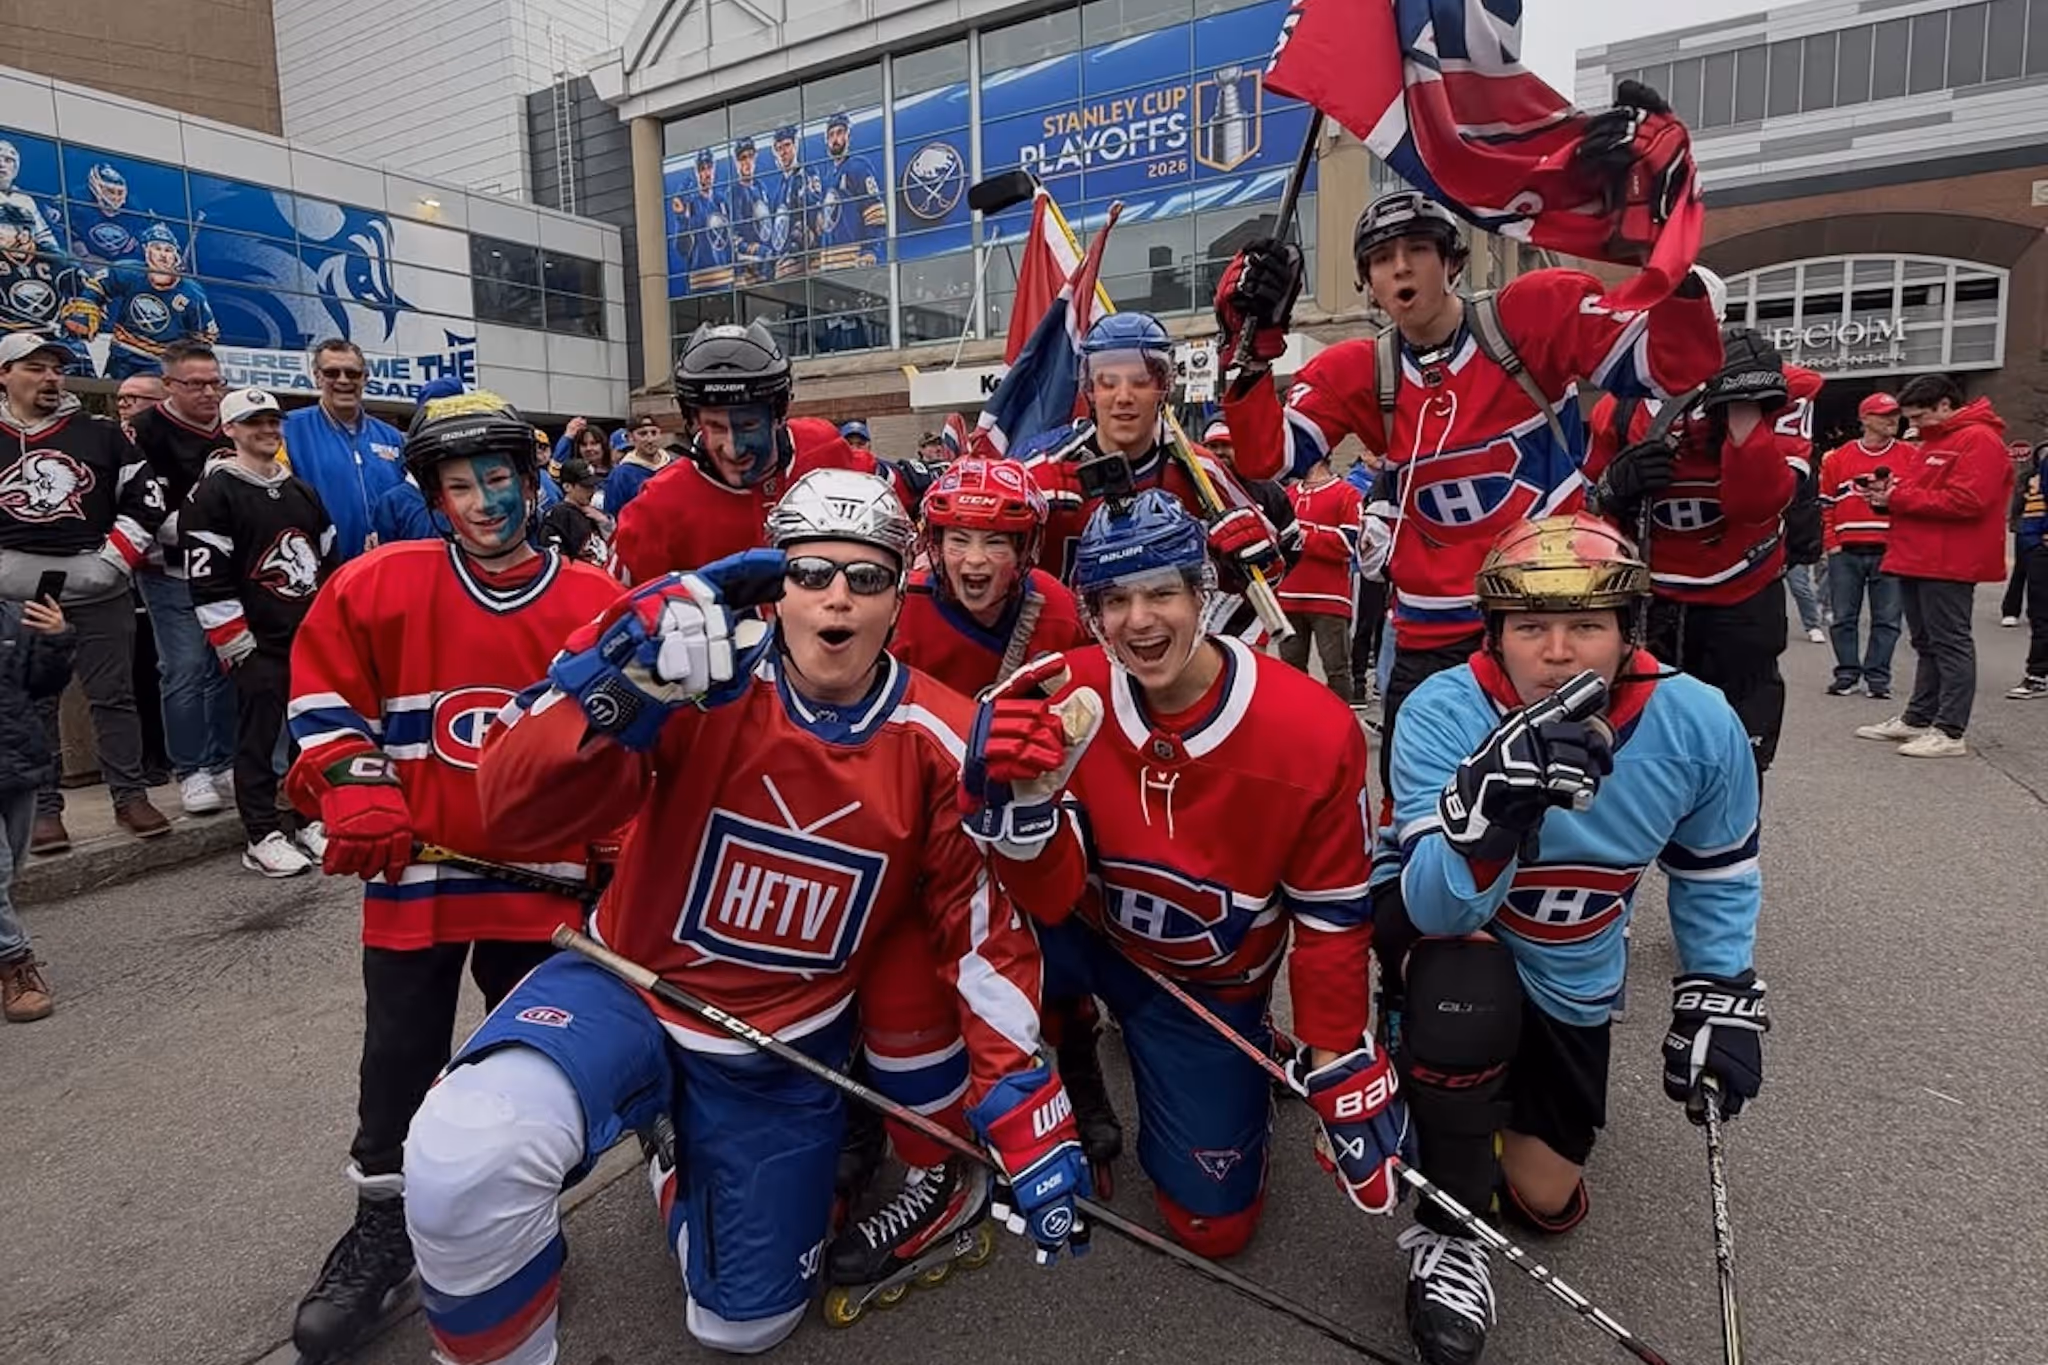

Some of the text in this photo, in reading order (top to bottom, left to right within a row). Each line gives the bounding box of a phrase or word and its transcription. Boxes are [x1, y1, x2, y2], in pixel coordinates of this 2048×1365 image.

[1043, 86, 1187, 139] STANLEY CUP
[1020, 113, 1187, 174] PLAYOFFS
[1147, 160, 1187, 178] 2026
[1773, 317, 1908, 350] ECOM
[219, 350, 476, 384] ERE ME THE
[224, 367, 421, 398] UFFA SAB
[1774, 397, 1814, 440] 20
[184, 546, 212, 580] 12
[718, 861, 839, 942] HFTV
[701, 1005, 774, 1047] CCM
[1335, 1068, 1399, 1119] BAU
